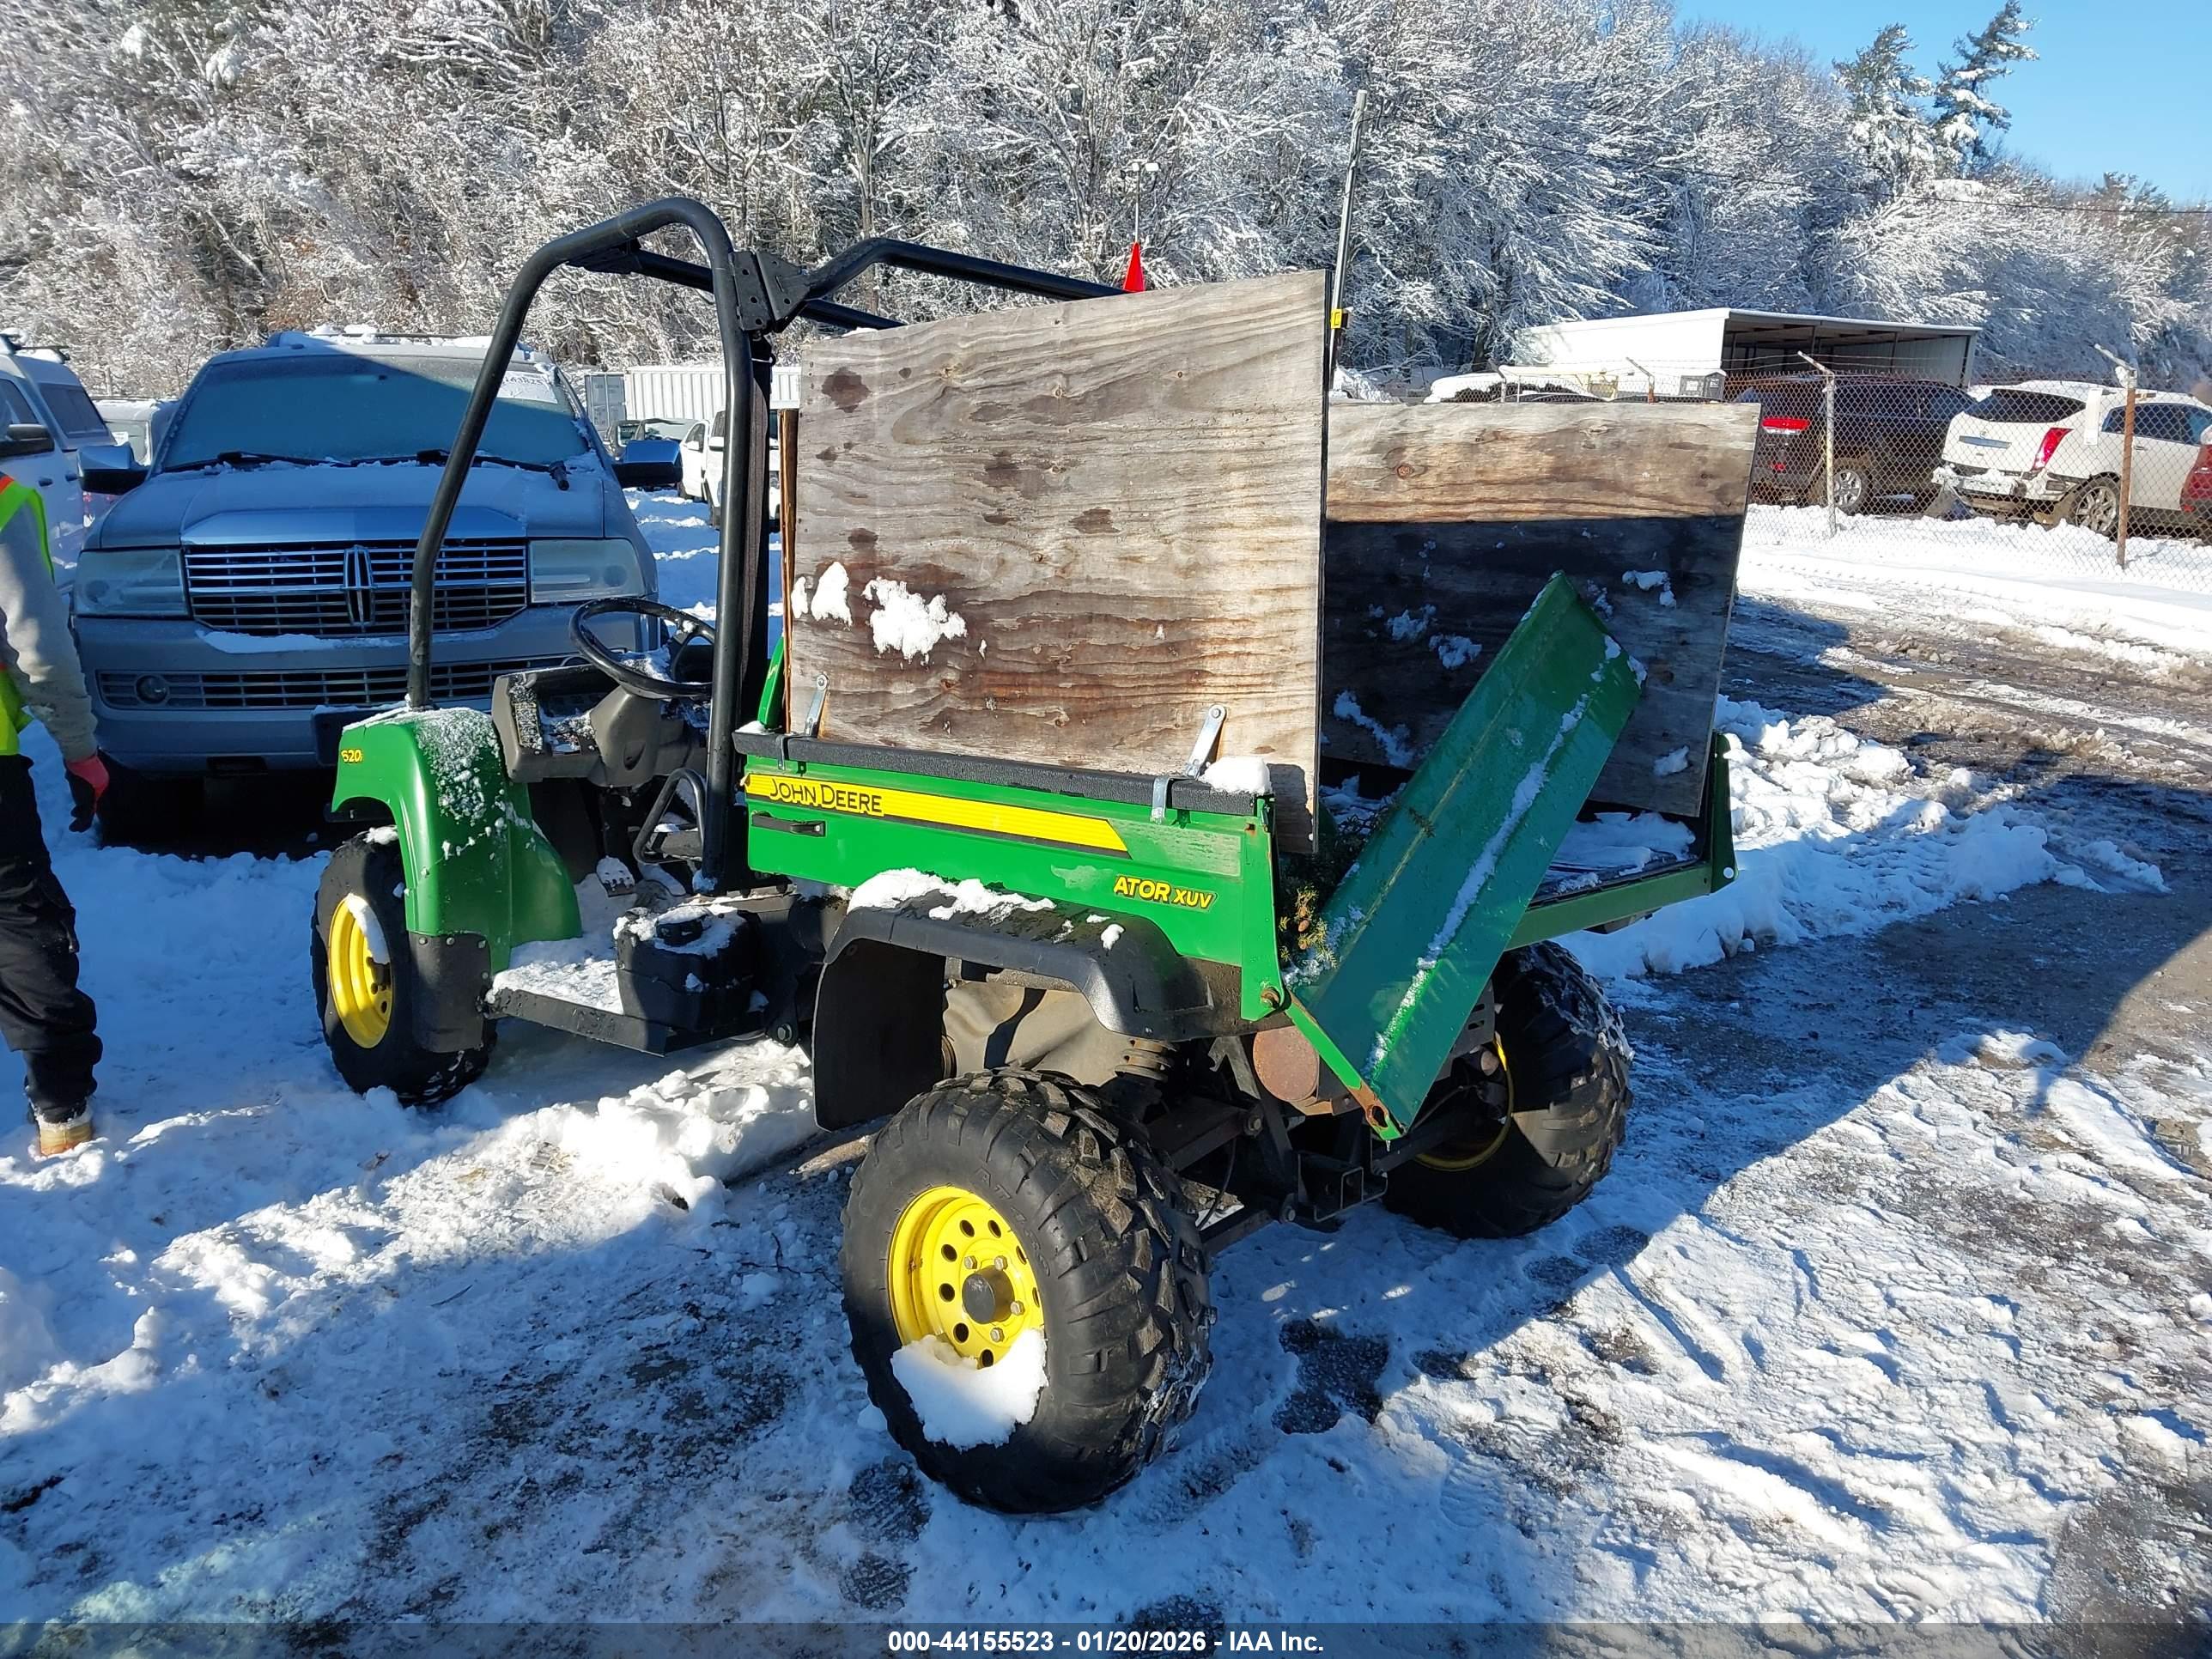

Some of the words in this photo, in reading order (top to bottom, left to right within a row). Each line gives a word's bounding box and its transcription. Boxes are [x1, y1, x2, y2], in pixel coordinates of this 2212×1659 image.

[769, 778, 817, 803] JOHN
[820, 784, 883, 813] DEERE
[1113, 875, 1171, 902] ATOR
[1172, 888, 1213, 908] XUV
